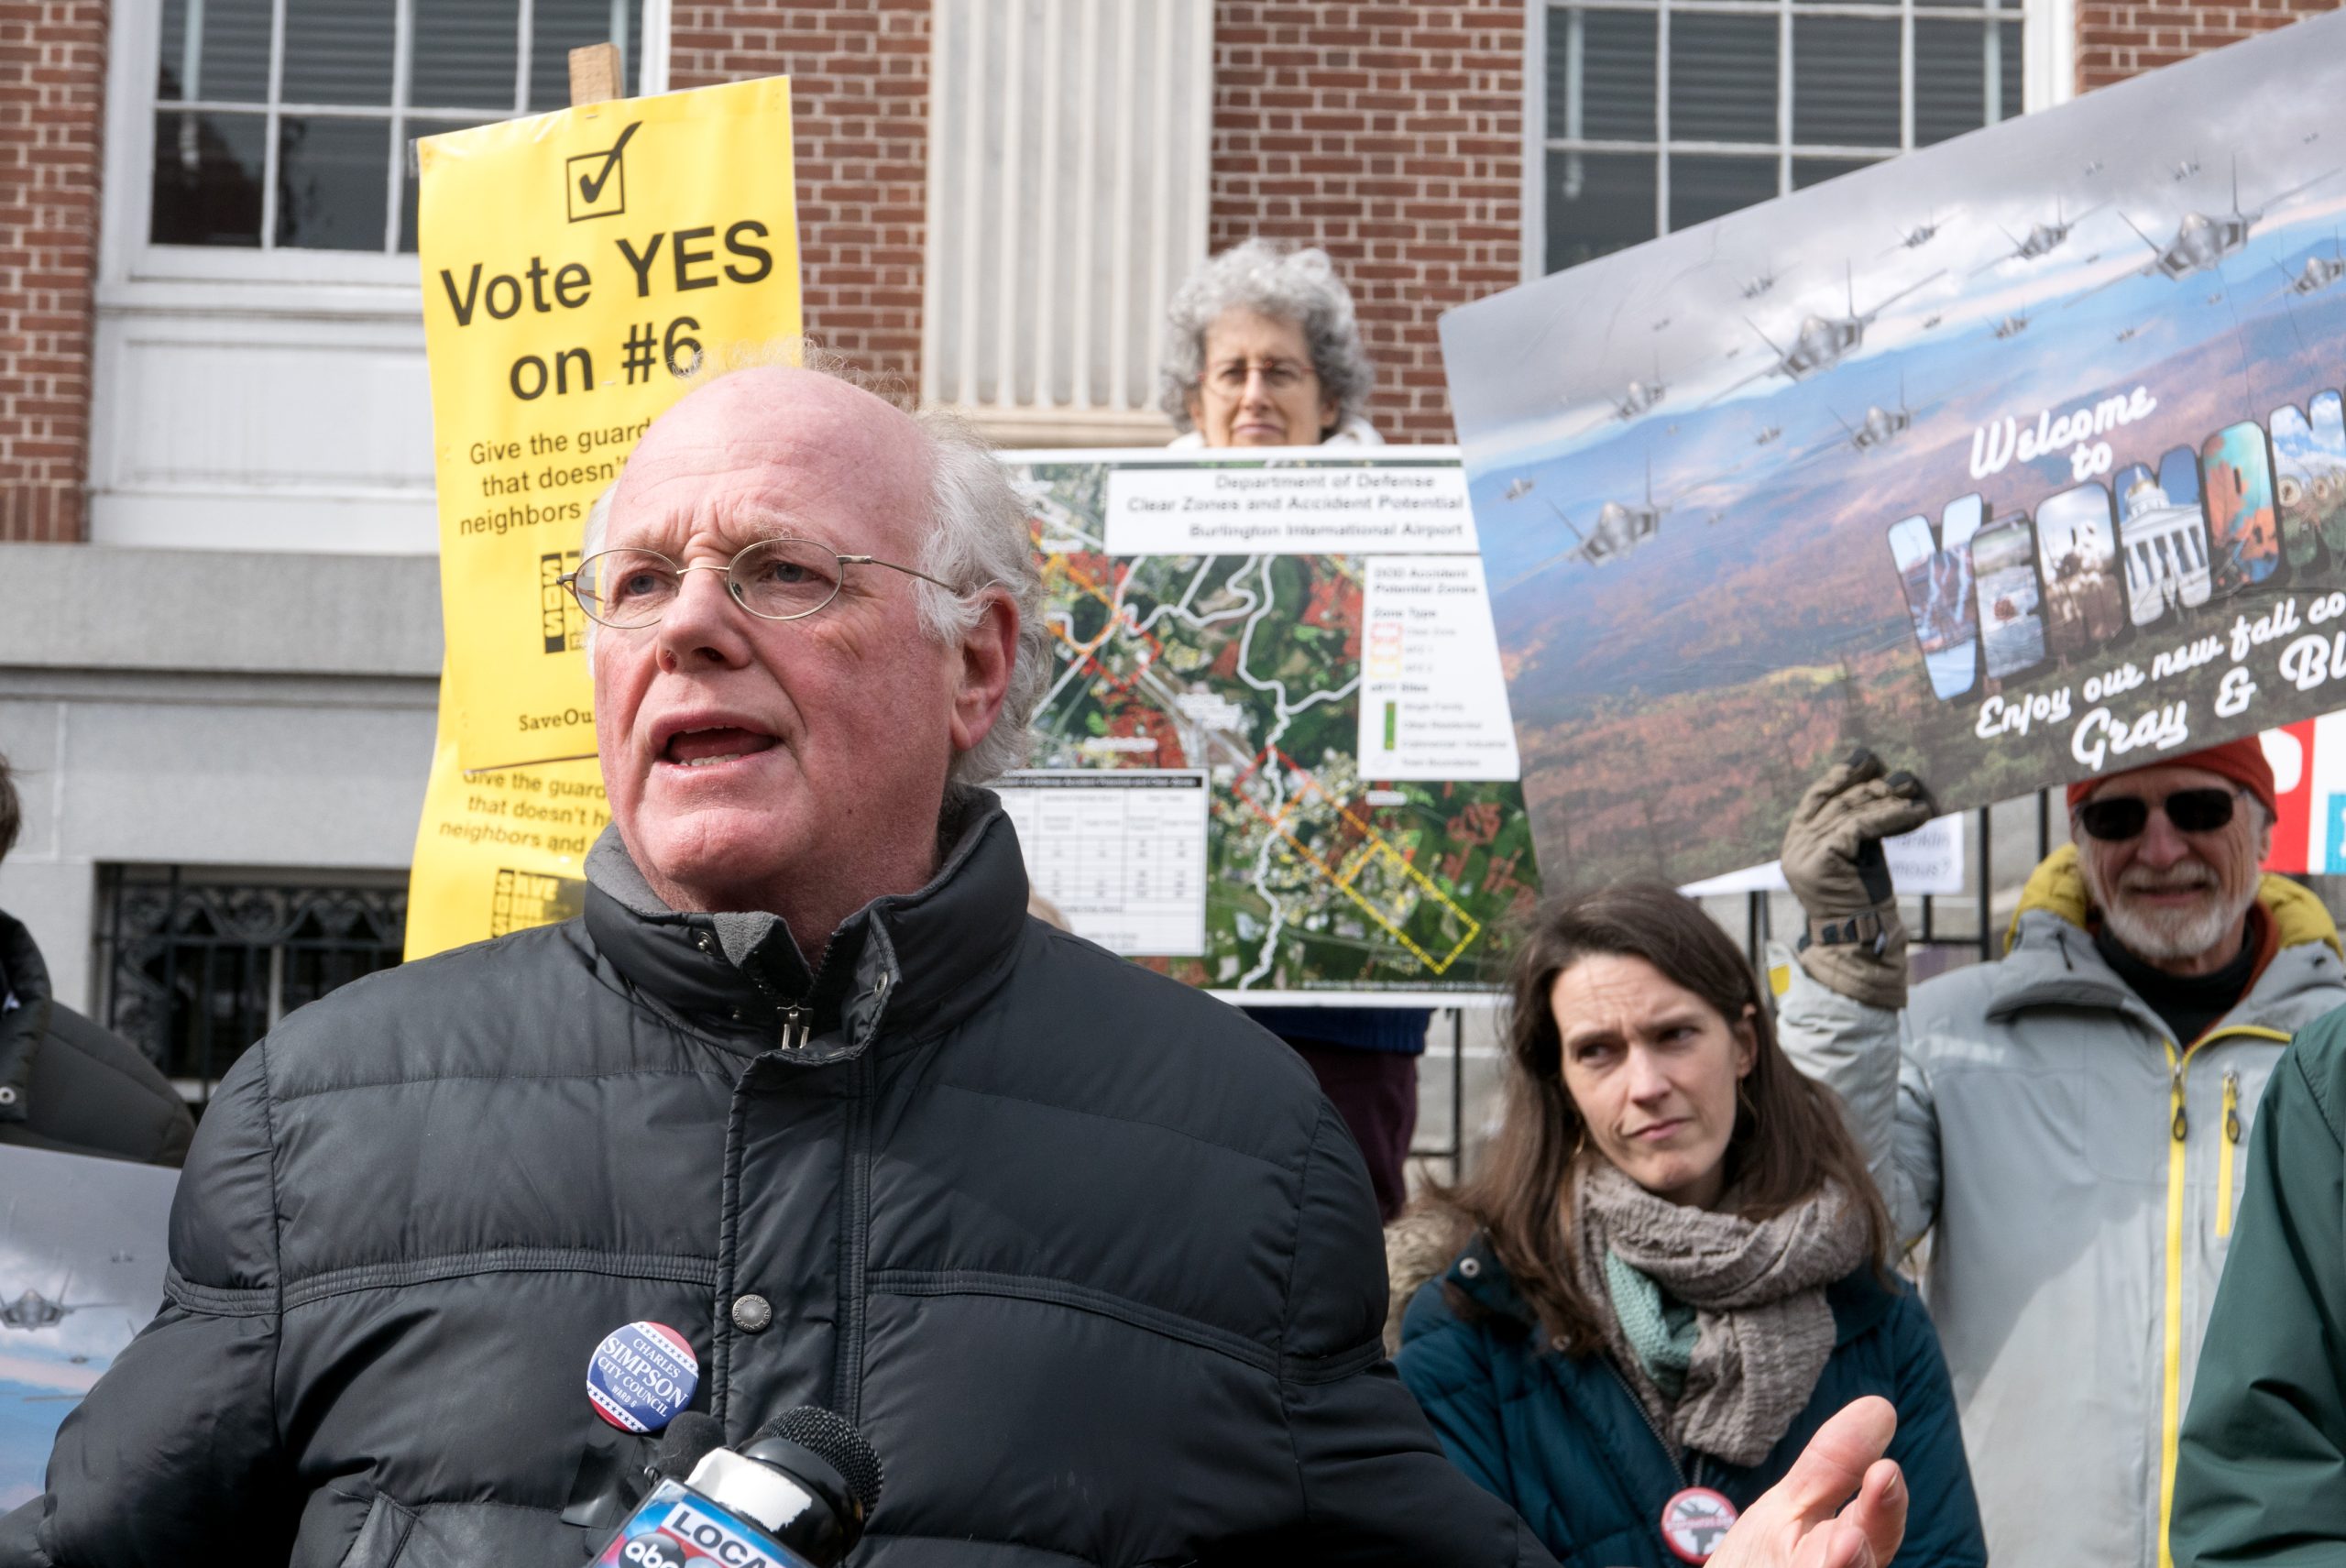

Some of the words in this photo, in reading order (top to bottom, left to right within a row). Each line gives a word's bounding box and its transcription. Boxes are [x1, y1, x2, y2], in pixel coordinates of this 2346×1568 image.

[440, 256, 592, 327] Vote
[616, 220, 773, 298] YES
[510, 346, 594, 401] on
[621, 316, 705, 385] #6
[470, 441, 521, 466] Give
[530, 433, 568, 455] the
[1969, 386, 2157, 480] Welcome
[482, 471, 530, 497] that
[538, 456, 628, 488] doesn'
[2069, 442, 2113, 482] to
[1215, 474, 1325, 491] Department
[1332, 474, 1351, 488] of
[1356, 474, 1435, 488] Defense
[460, 501, 582, 535] neighbors
[1126, 496, 1175, 511] Clear
[1182, 496, 1239, 511] Zones
[1246, 498, 1281, 510] and
[1288, 496, 1371, 510] Accident
[1377, 495, 1464, 510] Potential
[1189, 523, 1280, 541] Burlington
[1286, 523, 1397, 538] International
[1402, 523, 1464, 539] Airport
[1975, 686, 2071, 739] Enjoy
[2083, 663, 2145, 703] our
[2151, 635, 2225, 682] new
[2230, 598, 2301, 662] fall
[519, 708, 596, 731] SaveOu
[2071, 700, 2189, 773] Gray
[2214, 665, 2257, 718] &
[511, 773, 543, 792] the
[467, 795, 507, 816] that
[512, 801, 587, 825] doesn't
[439, 820, 541, 845] neighbors
[547, 835, 586, 854] and
[602, 1337, 689, 1409] SIMPSON
[633, 1338, 681, 1378] CHARLES
[597, 1356, 625, 1379] CITY
[622, 1376, 670, 1417] COUNCIL
[611, 1385, 632, 1403] WARD
[630, 1399, 638, 1409] 6
